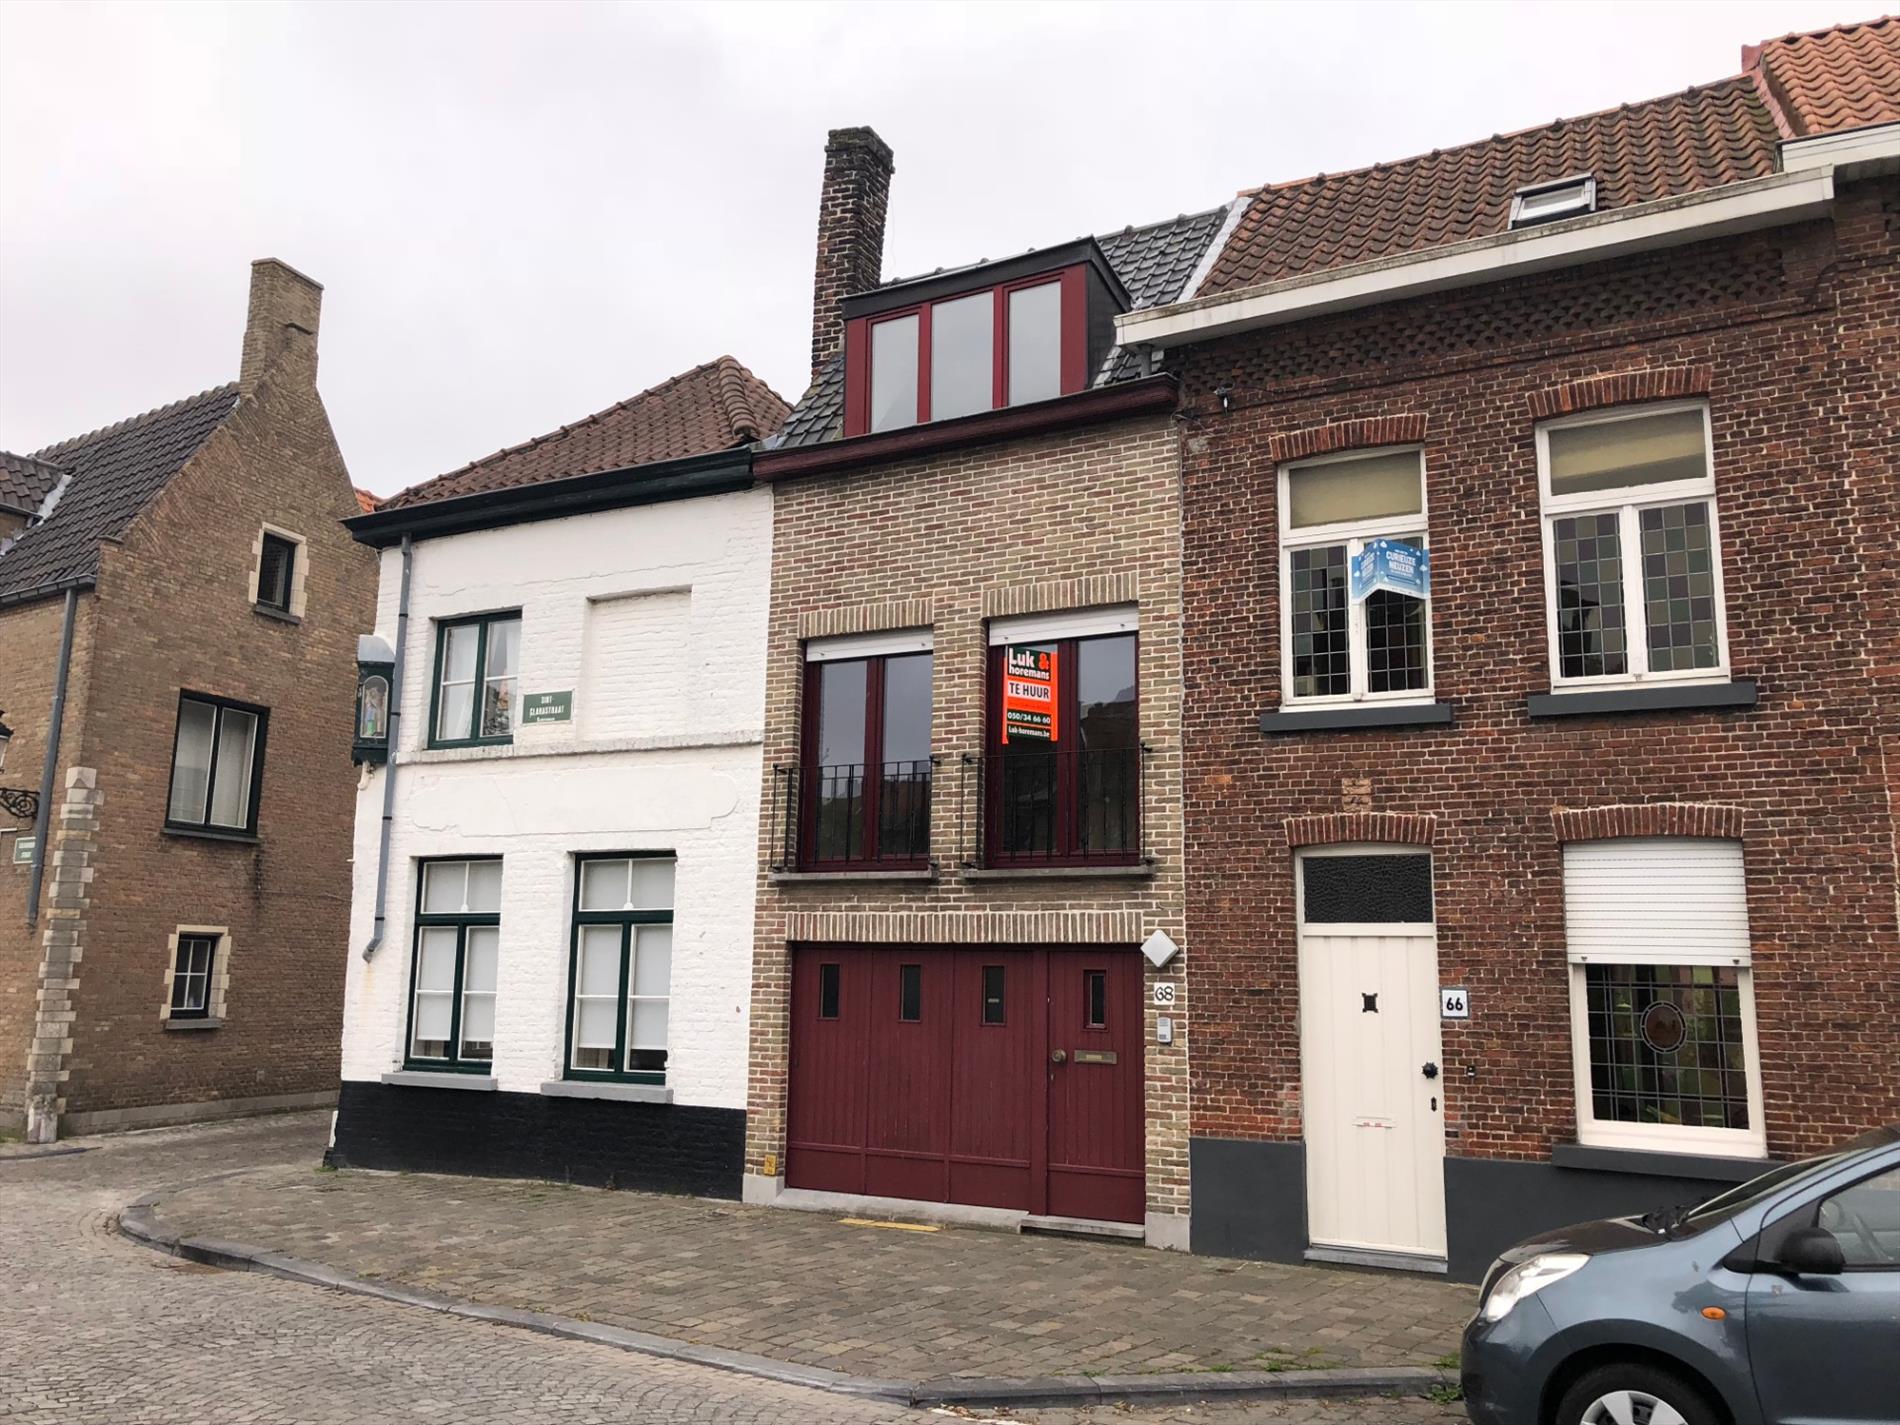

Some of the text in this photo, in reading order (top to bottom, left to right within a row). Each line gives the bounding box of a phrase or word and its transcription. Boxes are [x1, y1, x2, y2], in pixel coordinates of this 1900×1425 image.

[1009, 648, 1049, 670] Luk &
[1009, 664, 1049, 680] horemans
[1009, 682, 1049, 699] TE HUUR
[1007, 712, 1031, 722] 050/34
[1042, 716, 1050, 724] 60
[1155, 986, 1174, 1001] 68
[1446, 997, 1463, 1011] 66
